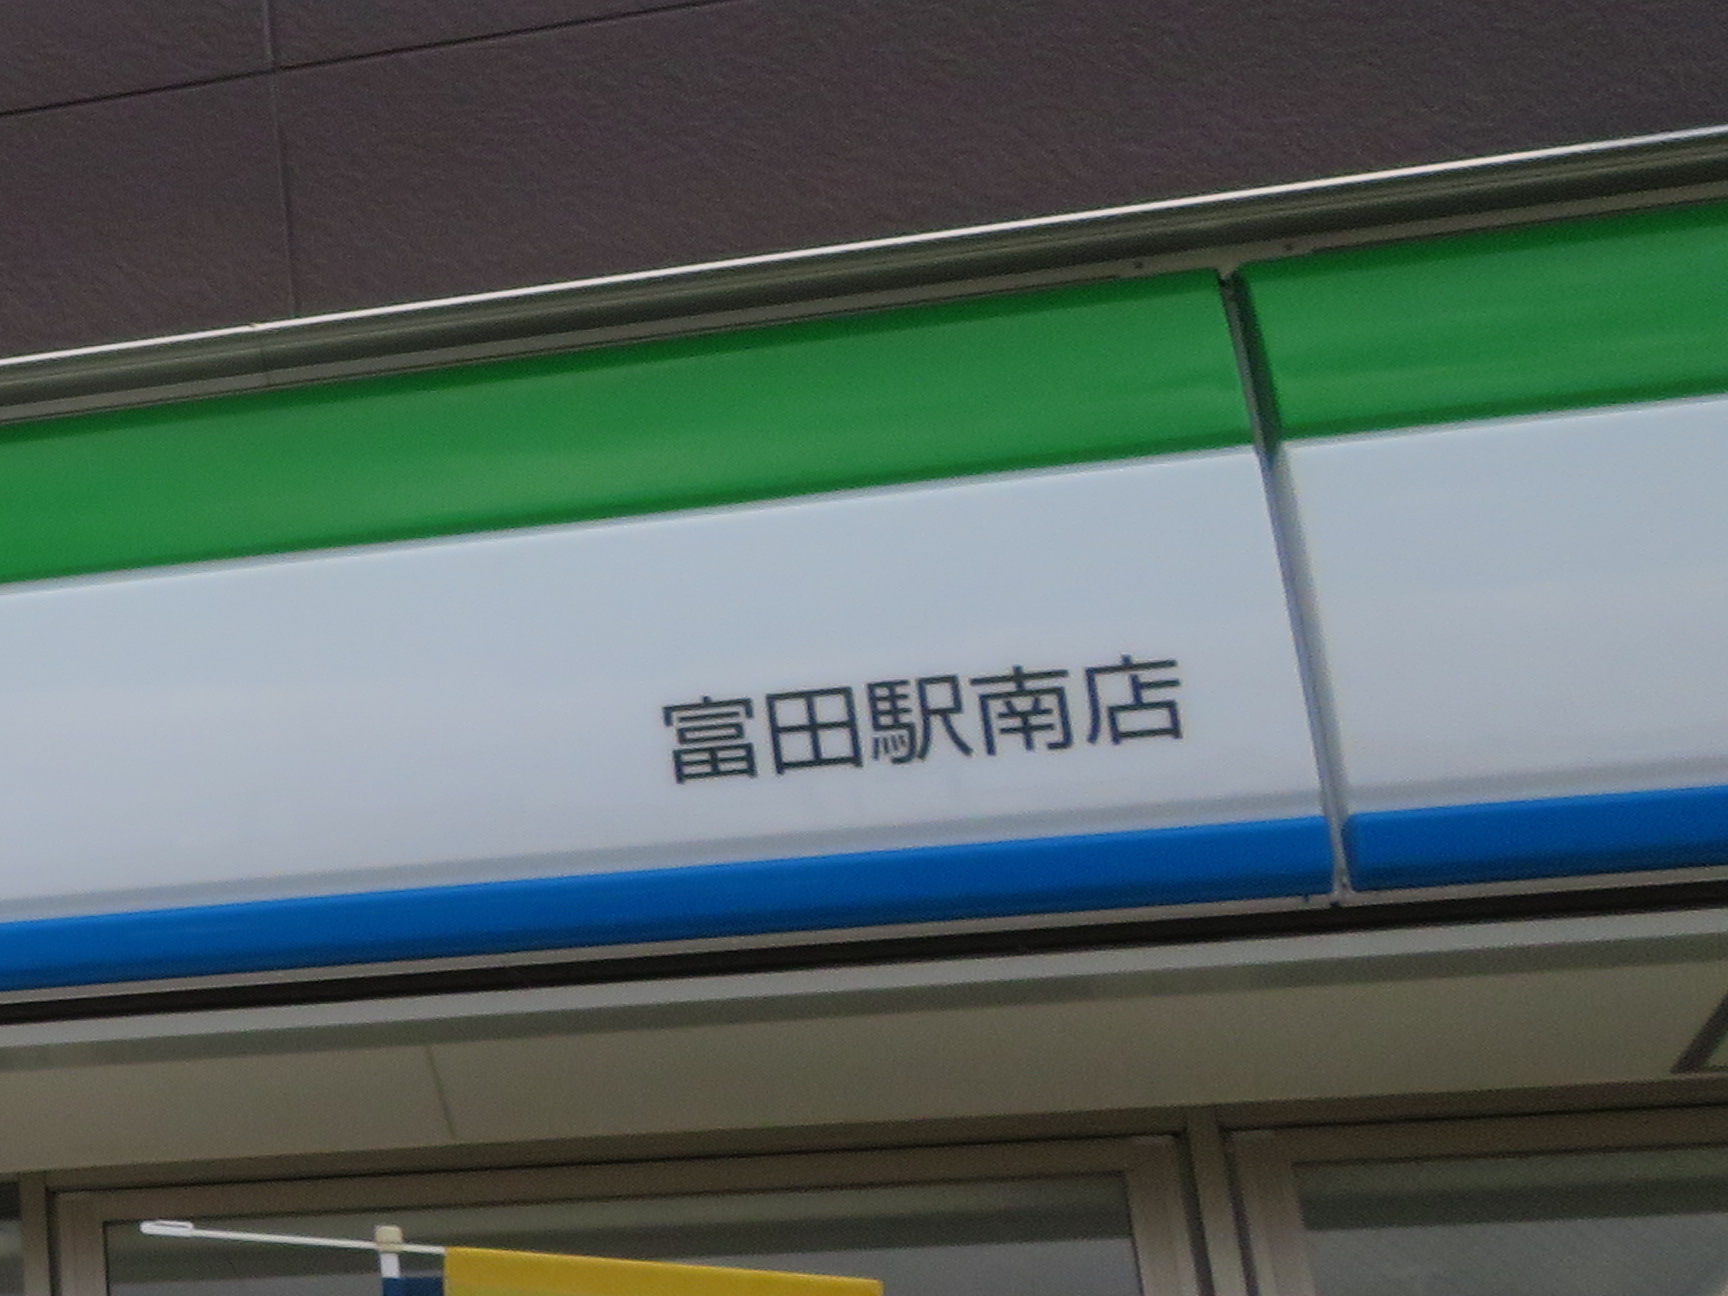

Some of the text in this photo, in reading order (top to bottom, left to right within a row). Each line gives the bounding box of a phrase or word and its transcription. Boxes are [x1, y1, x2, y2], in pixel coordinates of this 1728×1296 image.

[662, 653, 1183, 783] 富田駅南店
